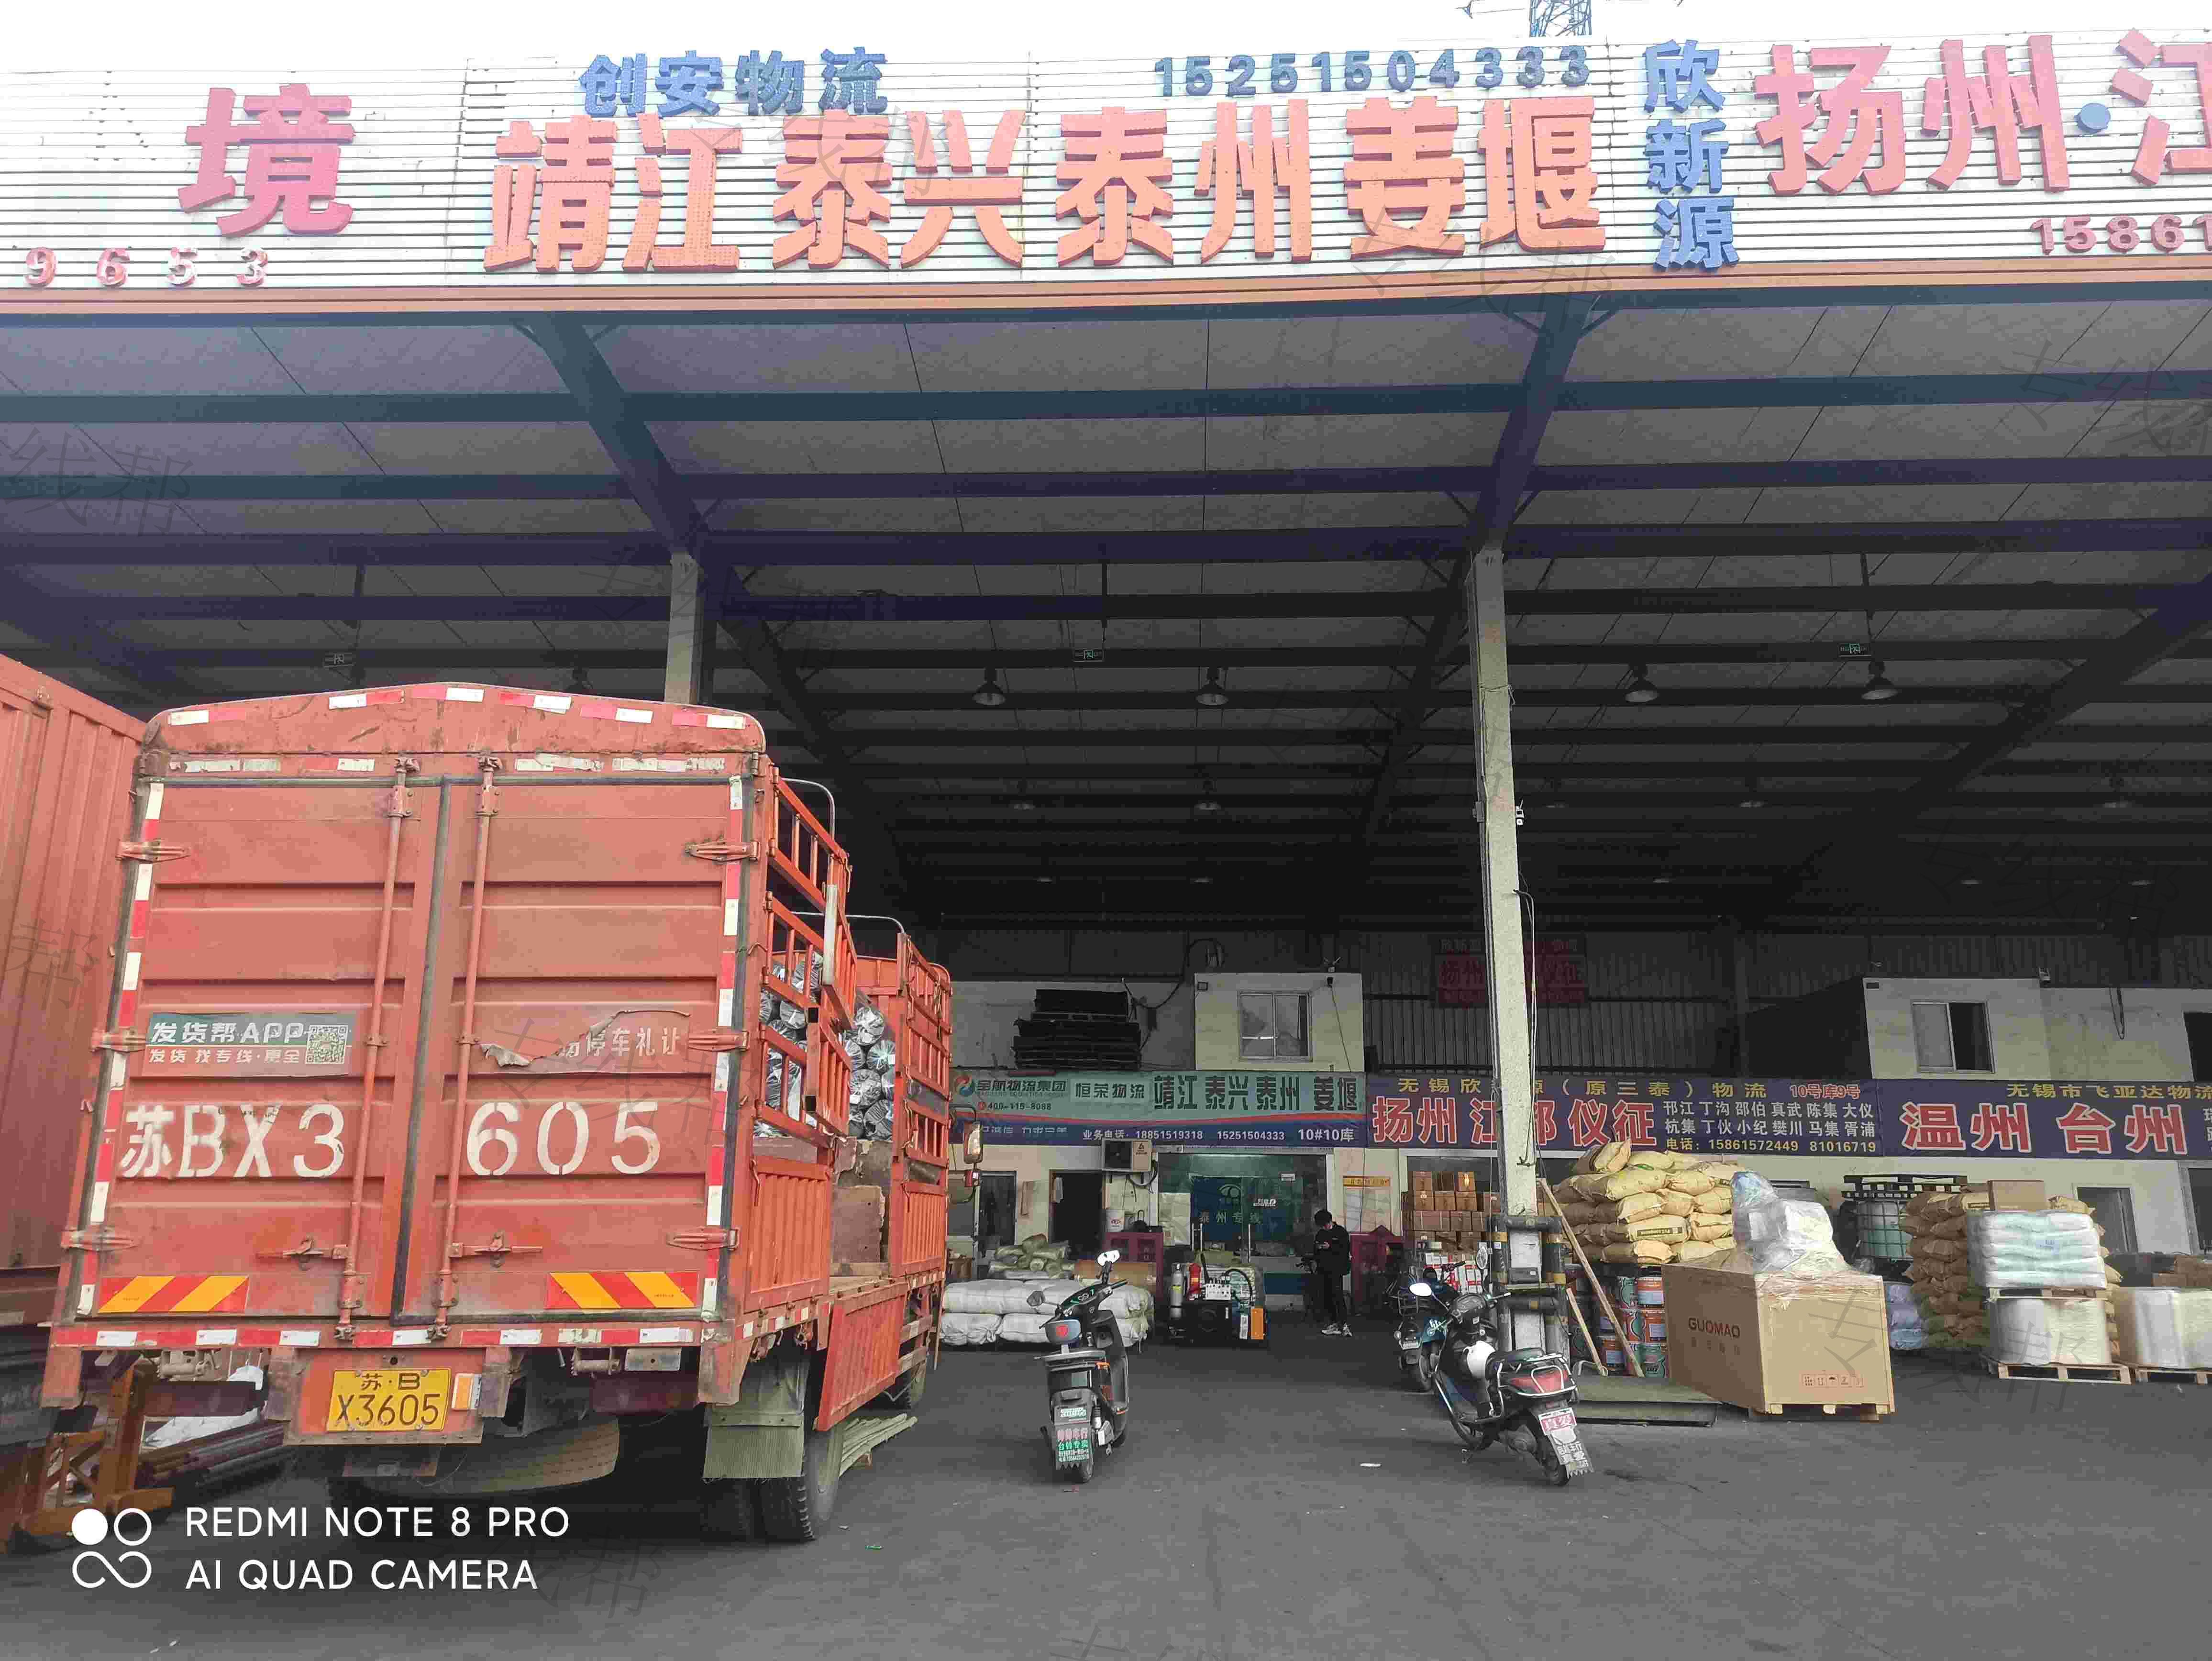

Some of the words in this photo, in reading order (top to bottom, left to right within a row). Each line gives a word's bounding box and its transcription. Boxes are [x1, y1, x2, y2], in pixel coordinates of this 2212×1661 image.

[578, 47, 887, 117] 创安物流
[1154, 45, 1590, 97] 15251504333
[177, 83, 355, 238] 境
[1643, 39, 1740, 272] 欣新源
[151, 1022, 304, 1044] 发货帮APP
[1075, 1082, 1145, 1100] 恒荣物流
[120, 1103, 345, 1178] 苏BX3
[466, 1101, 662, 1176] 605
[1135, 1130, 1203, 1140] 18851519318
[1217, 1131, 1285, 1141] 15251504333
[1708, 1139, 1799, 1152] 15861572449
[1809, 1141, 1876, 1152] 81016719
[1900, 1102, 2032, 1153] 温州
[2056, 1102, 2188, 1154] 台州
[1688, 1316, 1740, 1340] GUOMAO
[336, 1393, 441, 1426] X3605
